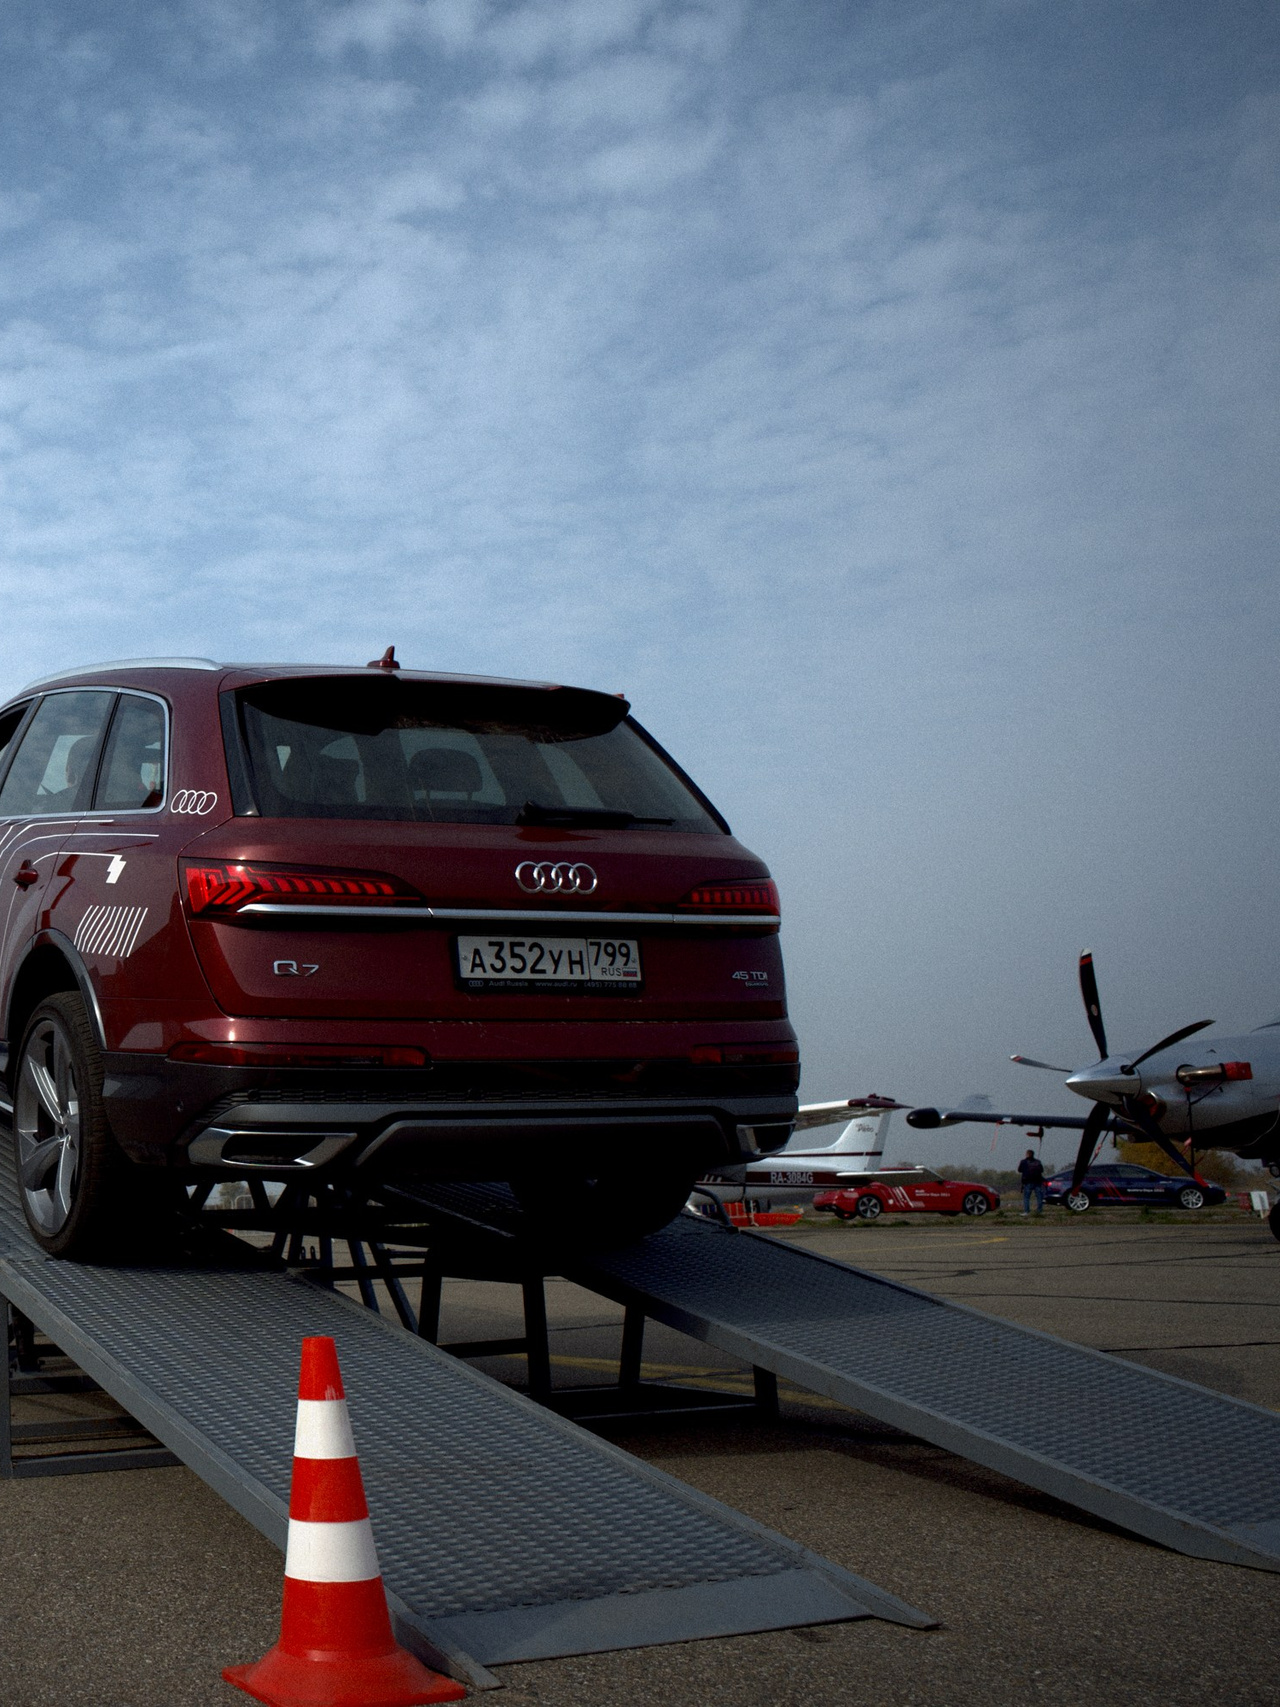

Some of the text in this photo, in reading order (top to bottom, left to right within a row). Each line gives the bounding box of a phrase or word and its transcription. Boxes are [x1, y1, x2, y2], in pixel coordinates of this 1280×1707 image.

[589, 941, 631, 966] 799
[273, 960, 320, 977] Q7
[601, 967, 622, 977] RUS
[731, 971, 768, 980] 45 TDI
